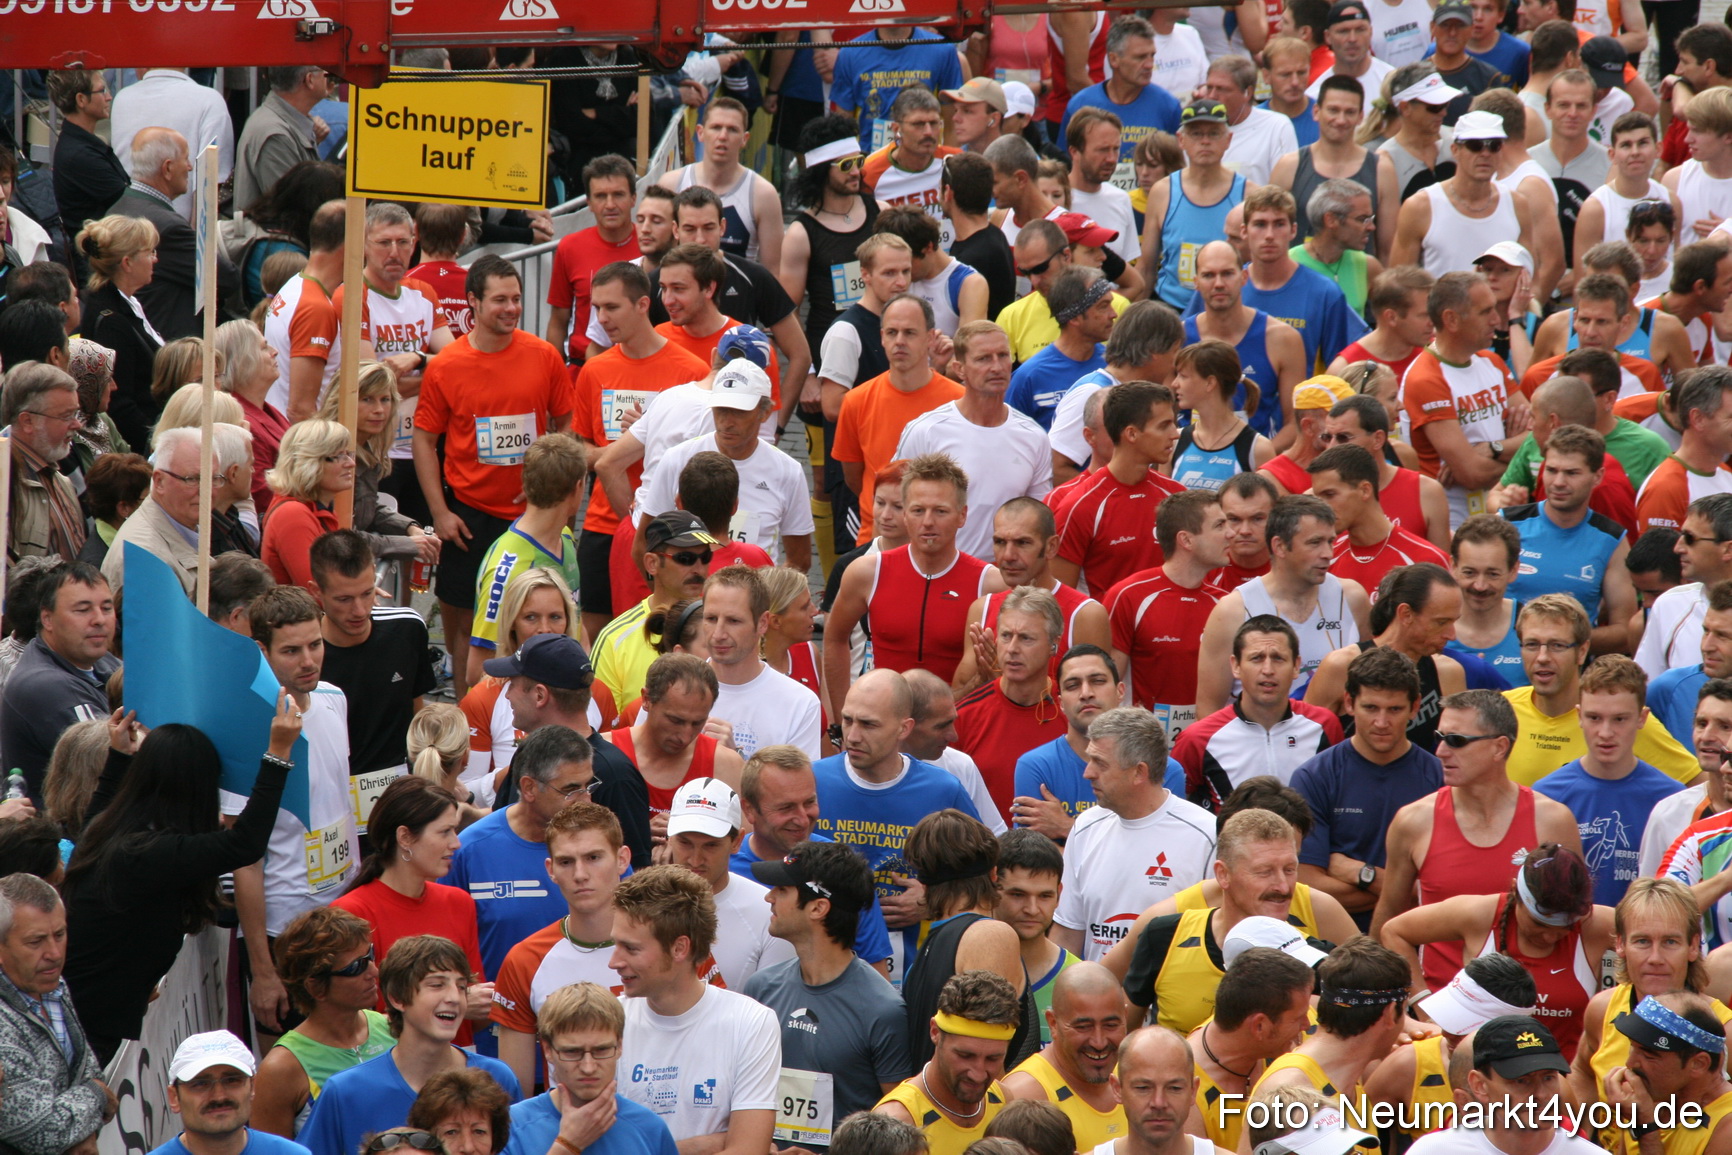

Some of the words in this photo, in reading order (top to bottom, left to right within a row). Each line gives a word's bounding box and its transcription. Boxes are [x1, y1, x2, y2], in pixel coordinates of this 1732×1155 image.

[872, 70, 931, 80] NEUMARKTER
[364, 103, 533, 140] Schnupper-
[421, 143, 476, 170] lauf
[494, 421, 516, 431] Armin
[496, 433, 531, 449] 2206
[1648, 517, 1680, 528] MERZ
[486, 553, 518, 621] BOCK
[1321, 618, 1342, 631] asics
[1535, 742, 1561, 750] Triathlon
[324, 827, 339, 843] Axel
[816, 819, 834, 831] 10.
[836, 820, 913, 838] NEUMARKT
[331, 840, 350, 864] 199
[1614, 849, 1640, 860] HERBST
[1614, 869, 1638, 881] 2006
[1533, 1006, 1573, 1018] nbach
[788, 1020, 818, 1035] skinfit
[631, 1064, 649, 1083] 6.
[645, 1065, 679, 1075] Neumarkter
[651, 1072, 678, 1082] Stadtlauf
[783, 1096, 818, 1120] 975
